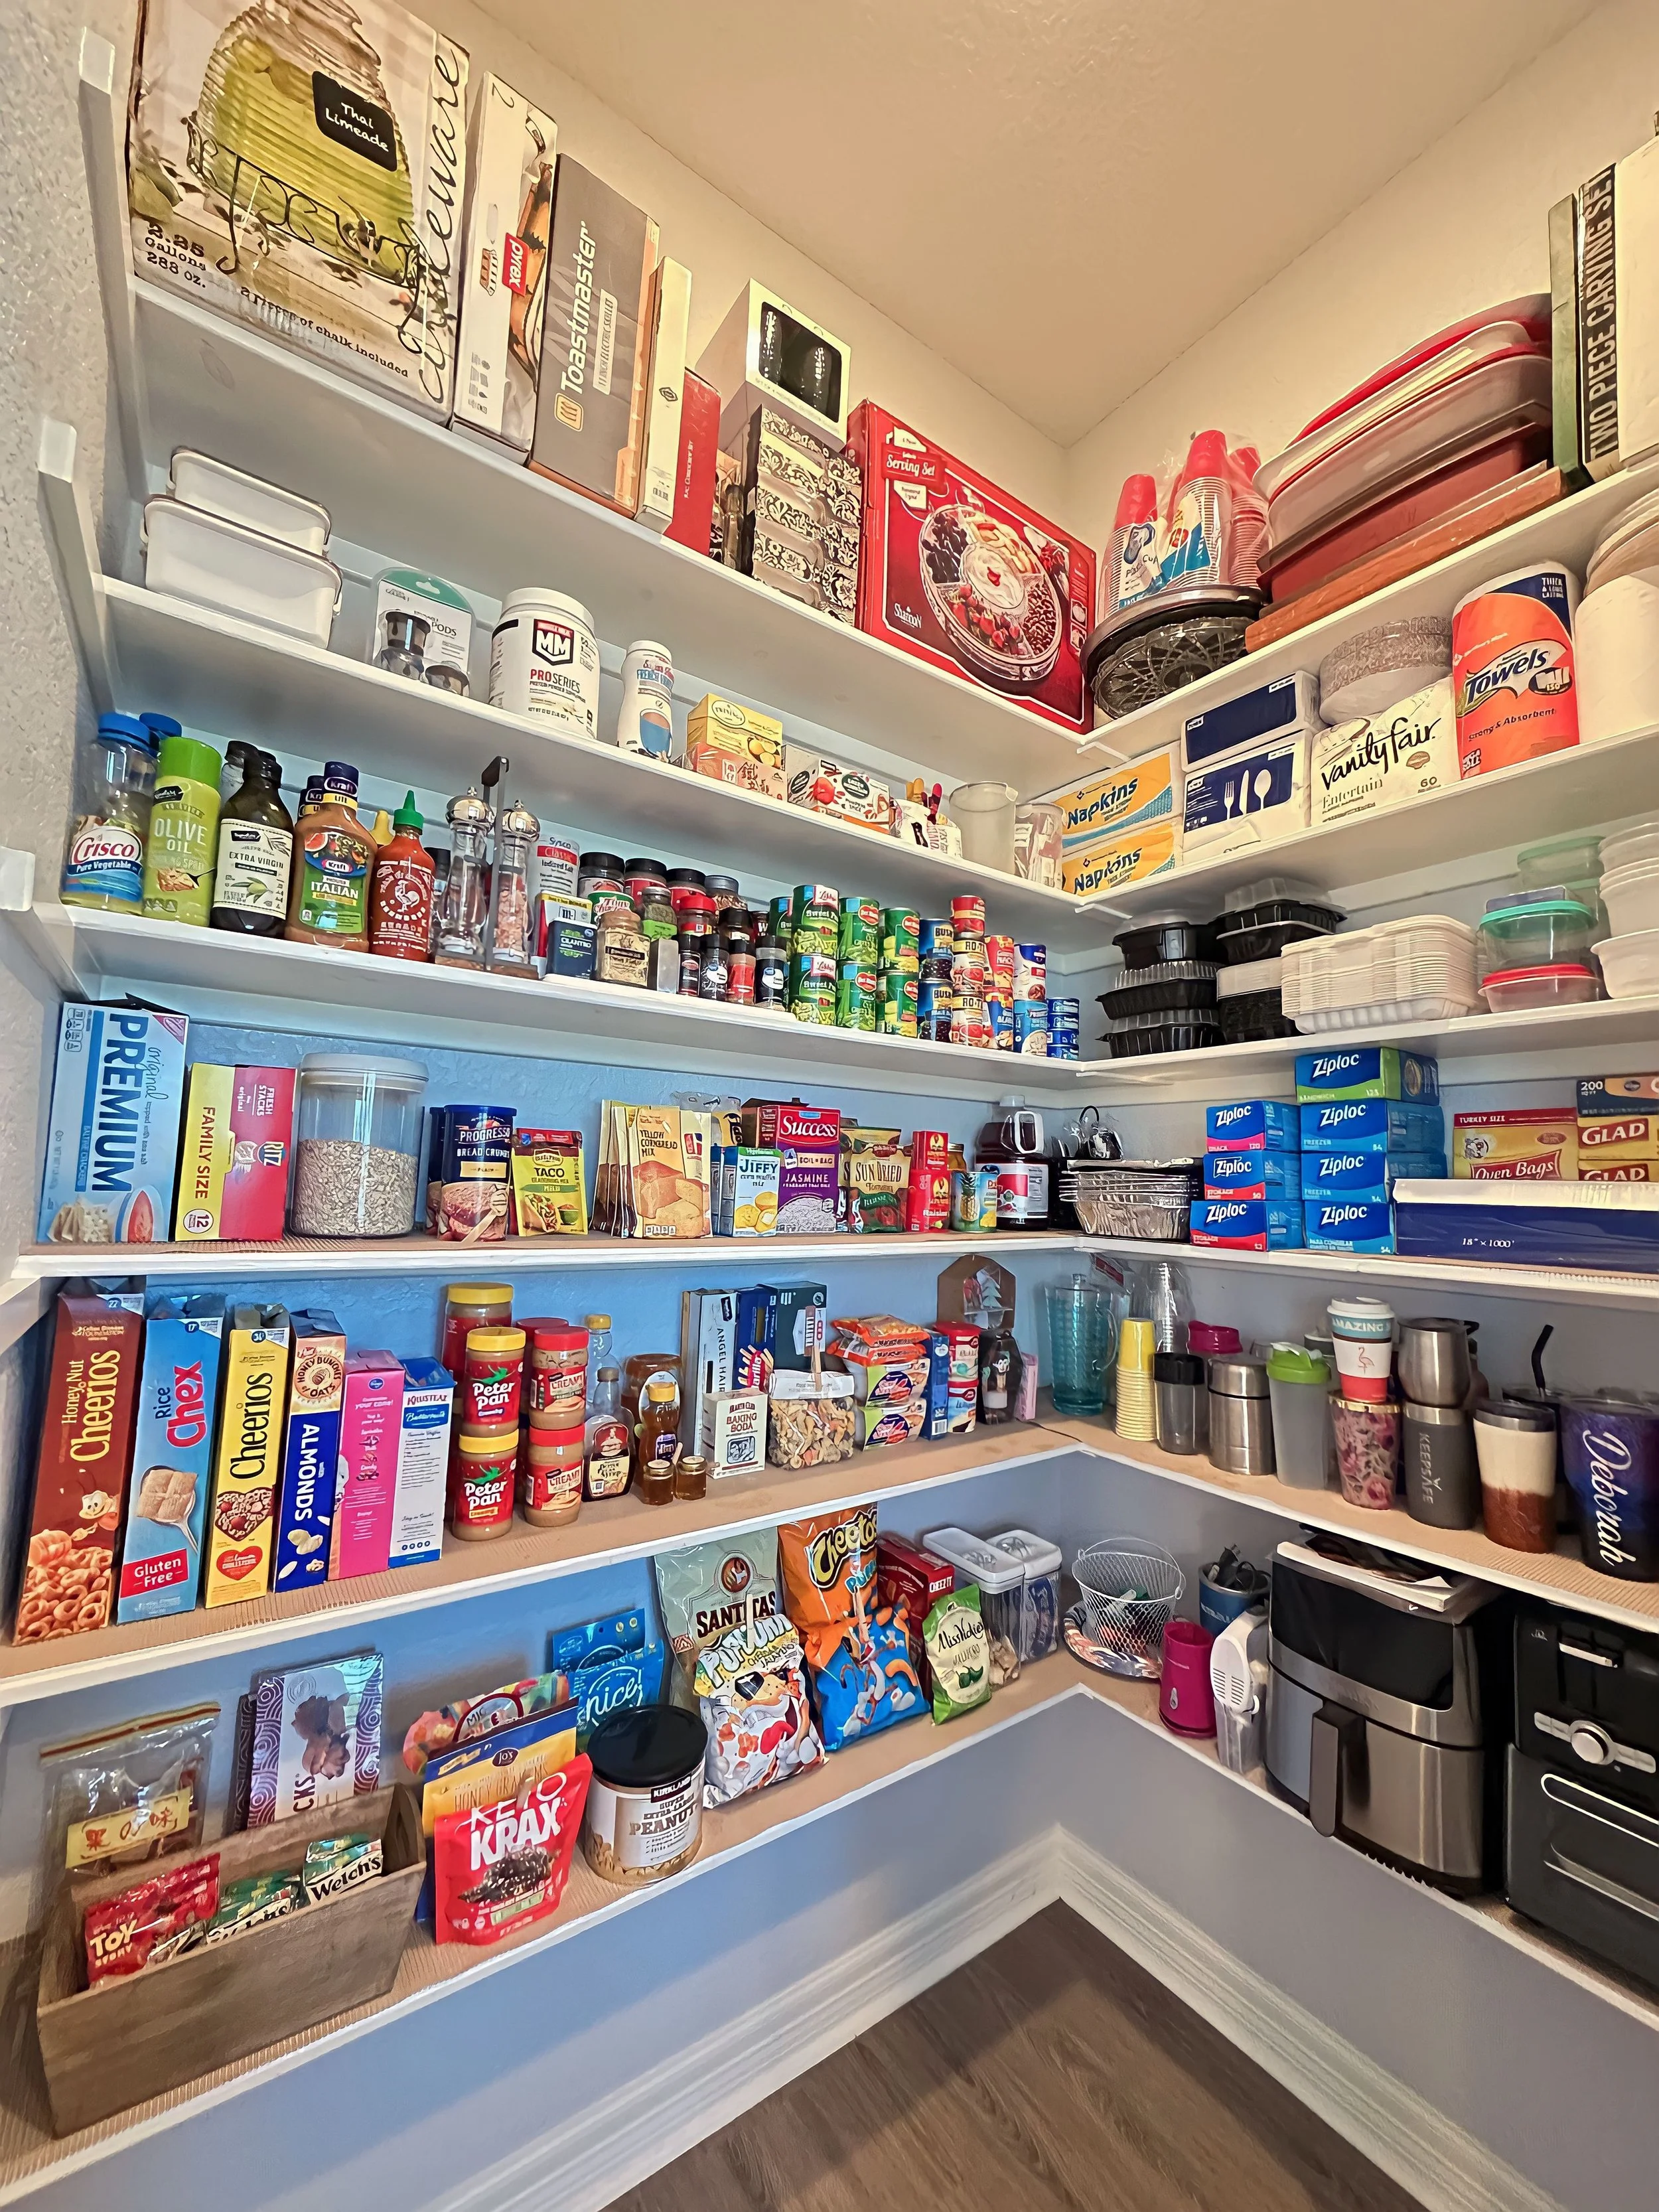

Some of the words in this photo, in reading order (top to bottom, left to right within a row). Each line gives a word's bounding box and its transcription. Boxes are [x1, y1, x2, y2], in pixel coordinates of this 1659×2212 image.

[340, 102, 374, 131] Thai
[325, 107, 390, 153] Limeade
[1585, 166, 1613, 219] SET
[147, 221, 206, 258] 2.25
[145, 236, 207, 271] Gallons
[147, 252, 179, 275] 288
[508, 236, 526, 289] pyrex
[1582, 220, 1617, 328] CARVING
[560, 220, 598, 396] Toastmaster
[301, 315, 314, 327] of
[316, 324, 354, 350] chalk
[355, 346, 409, 378] included
[1588, 324, 1618, 400] PIECE
[1589, 403, 1619, 463] TWO
[886, 454, 920, 477] Serving
[431, 620, 458, 637] PODS
[536, 629, 571, 657] MM
[1466, 648, 1550, 706] Towels
[1503, 708, 1556, 725] Absorbent
[1420, 776, 1438, 788] 60
[1066, 778, 1139, 830] Napkins
[154, 818, 209, 847] OLIVE
[71, 837, 134, 865] Crisco
[166, 840, 192, 855] OIL
[229, 851, 253, 864] EXTRA
[256, 854, 285, 869] VIRGIN
[1073, 848, 1143, 895] Napkins
[311, 882, 359, 900] ITALIAN
[1313, 1054, 1360, 1078] Ziploc
[1580, 1080, 1604, 1092] 200
[92, 1013, 149, 1192] PREMIUM
[780, 1116, 837, 1137] Success
[1216, 1106, 1252, 1128] Ziploc
[1320, 1104, 1366, 1127] Ziploc
[200, 1107, 216, 1161] FAMILY
[460, 1127, 511, 1143] PROGRESSO
[1581, 1122, 1647, 1145] GLAD
[263, 1141, 285, 1167] RITZ
[457, 1147, 484, 1157] BREAD
[534, 1167, 565, 1179] TACO
[739, 1159, 778, 1174] JIFFY
[855, 1161, 875, 1182] SUN
[877, 1161, 902, 1183] DRIED
[1216, 1159, 1252, 1177] Ziploc
[1319, 1155, 1364, 1177] Ziploc
[1515, 1159, 1555, 1179] Bags
[1583, 1167, 1648, 1181] GLAD
[194, 1165, 210, 1200] SIZE
[785, 1173, 829, 1183] JASMINE
[196, 1214, 210, 1228] 12
[1206, 1203, 1248, 1224] Ziploc
[1321, 1205, 1368, 1226] Ziploc
[1333, 1317, 1384, 1333] AMAZING
[717, 1327, 727, 1363] ANGEL
[66, 1359, 85, 1383] Nut
[296, 1357, 315, 1383] HONEY
[317, 1356, 342, 1380] BUNCHES
[309, 1383, 336, 1398] OATS
[472, 1381, 516, 1397] Peter
[551, 1374, 584, 1390] CREAMY
[60, 1384, 80, 1425] Honey
[70, 1349, 121, 1461] Cheerios
[155, 1386, 171, 1420] Rice
[166, 1361, 208, 1449] Chex
[476, 1392, 510, 1410] Pan
[230, 1372, 273, 1480] Cheerios
[294, 1423, 321, 1522] ALMONDS
[549, 1469, 581, 1487] CREAMY
[464, 1479, 508, 1500] Peter
[1582, 1428, 1636, 1567] Deborah
[467, 1493, 502, 1511] Pan
[133, 1556, 182, 1580] Gluten
[144, 1570, 173, 1588] Free
[653, 1777, 691, 1797] KIRKLAND
[470, 1797, 562, 1872] KRAX
[310, 1856, 382, 1901] Welch's
[90, 1918, 138, 1958] TOY
